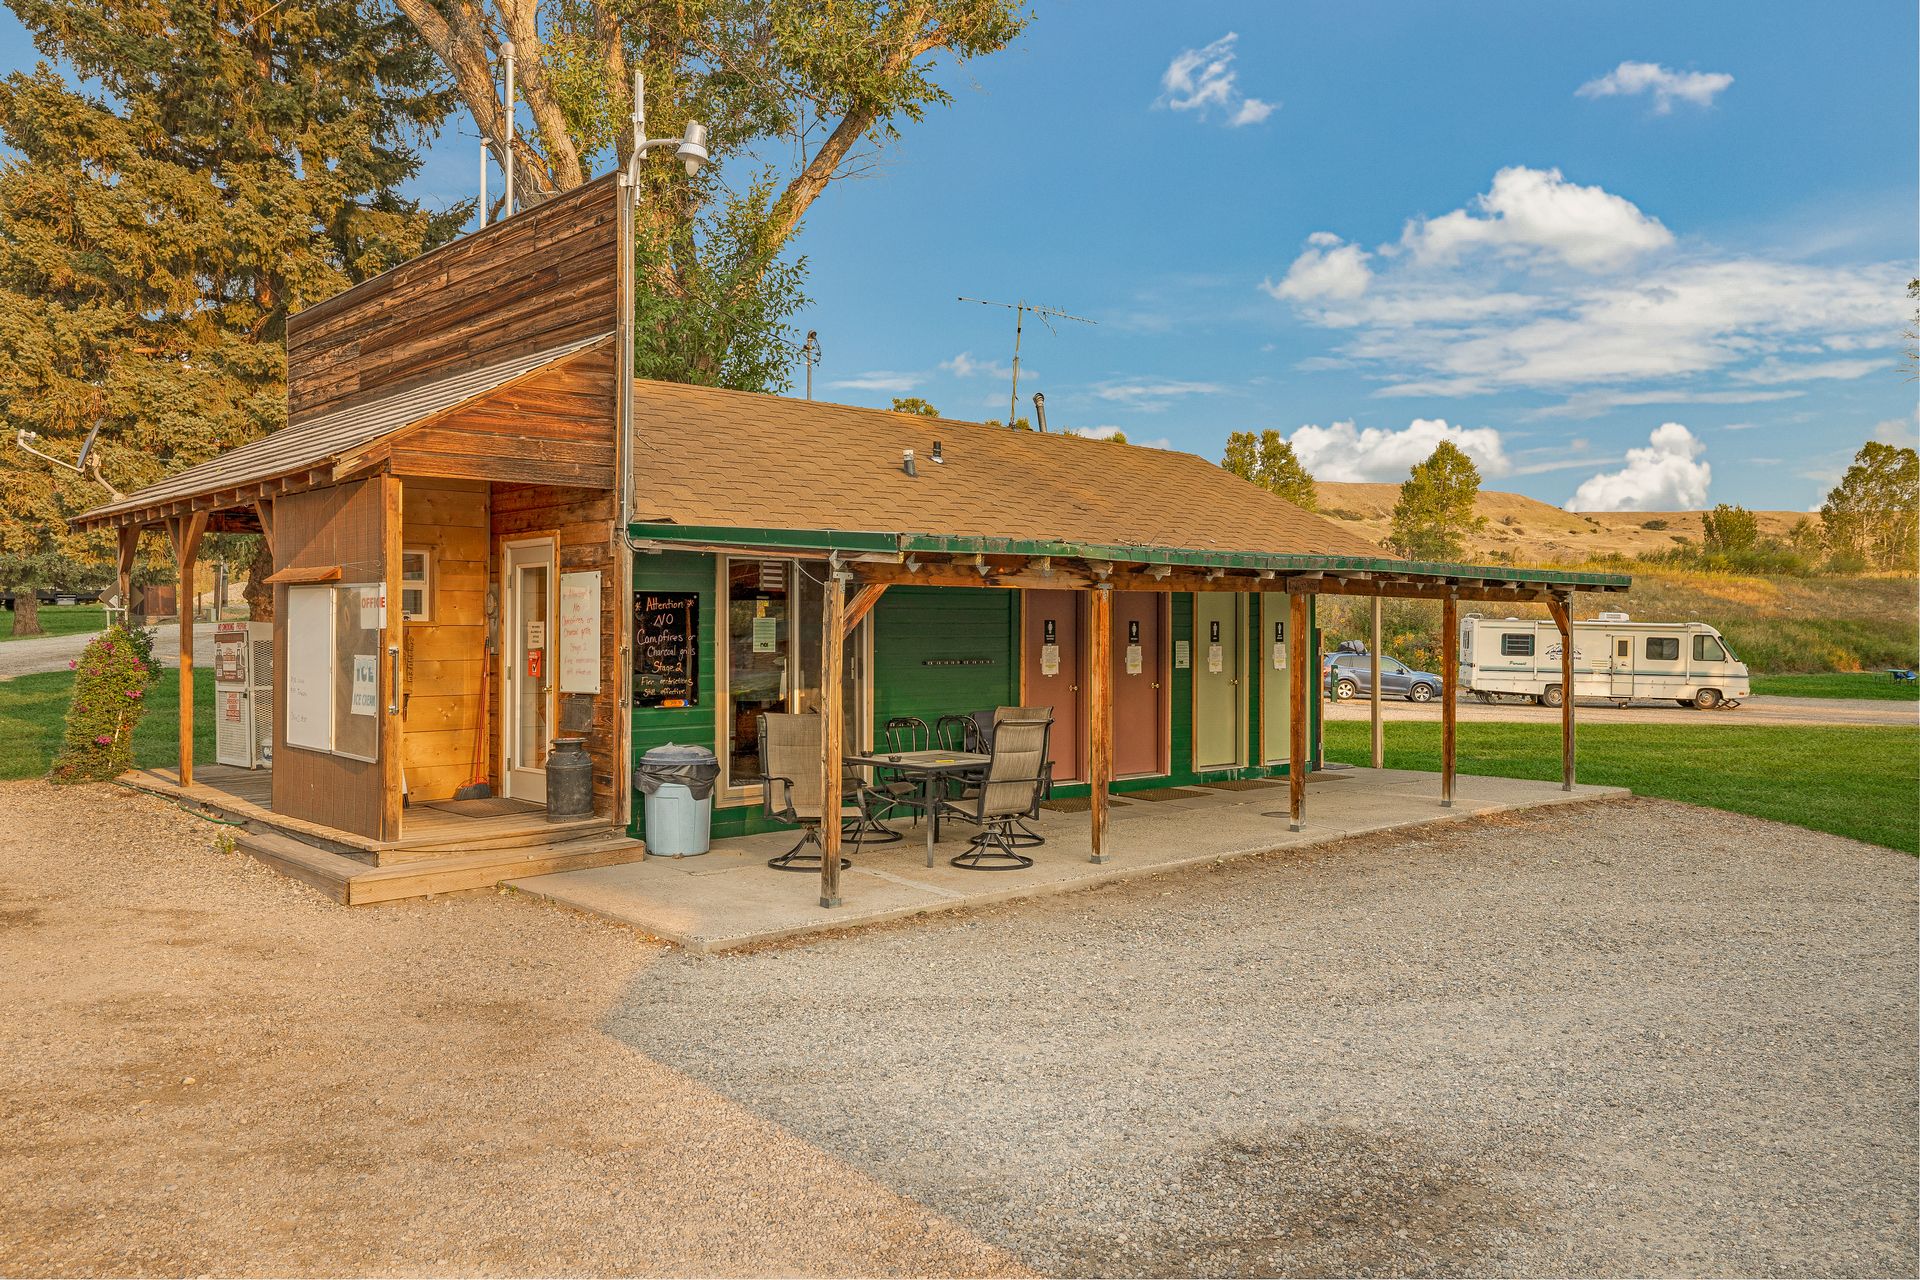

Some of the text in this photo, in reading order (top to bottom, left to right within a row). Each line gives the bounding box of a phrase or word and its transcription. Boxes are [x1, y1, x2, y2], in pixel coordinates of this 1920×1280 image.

[646, 597, 684, 611] Attention
[653, 613, 674, 625] NO
[637, 628, 684, 645] Campfires
[356, 666, 374, 683] ICE
